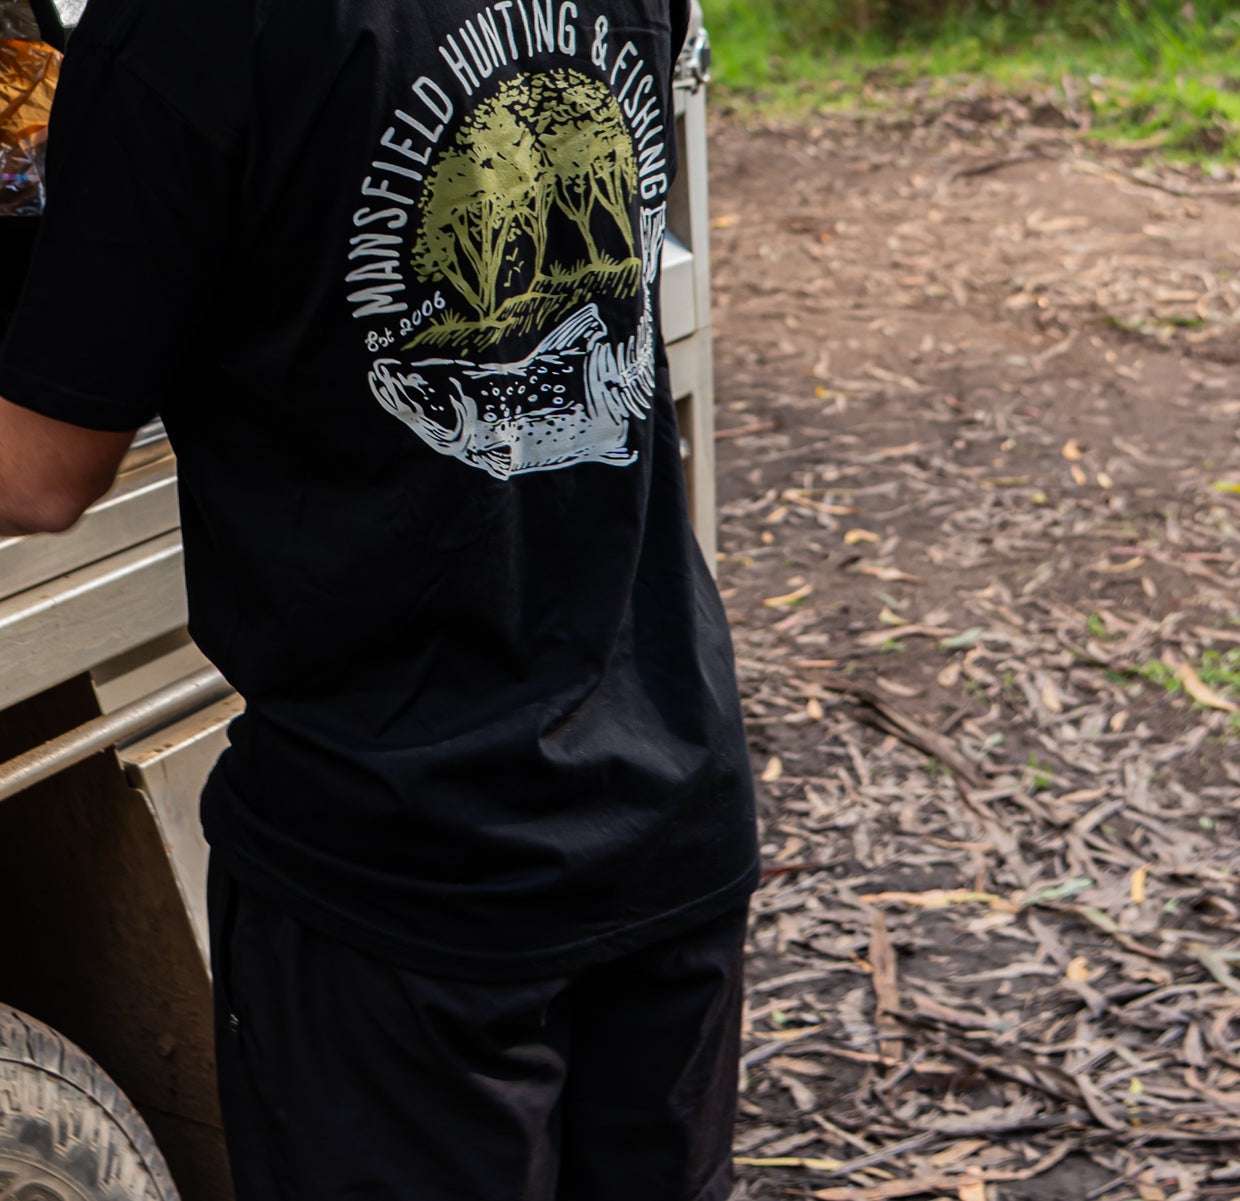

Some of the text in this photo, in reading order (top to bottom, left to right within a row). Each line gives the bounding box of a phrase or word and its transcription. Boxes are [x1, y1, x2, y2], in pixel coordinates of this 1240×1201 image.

[345, 76, 453, 318] MANSFIELD
[591, 15, 608, 71] &
[611, 41, 667, 200] FISHING
[400, 290, 446, 336] 2006
